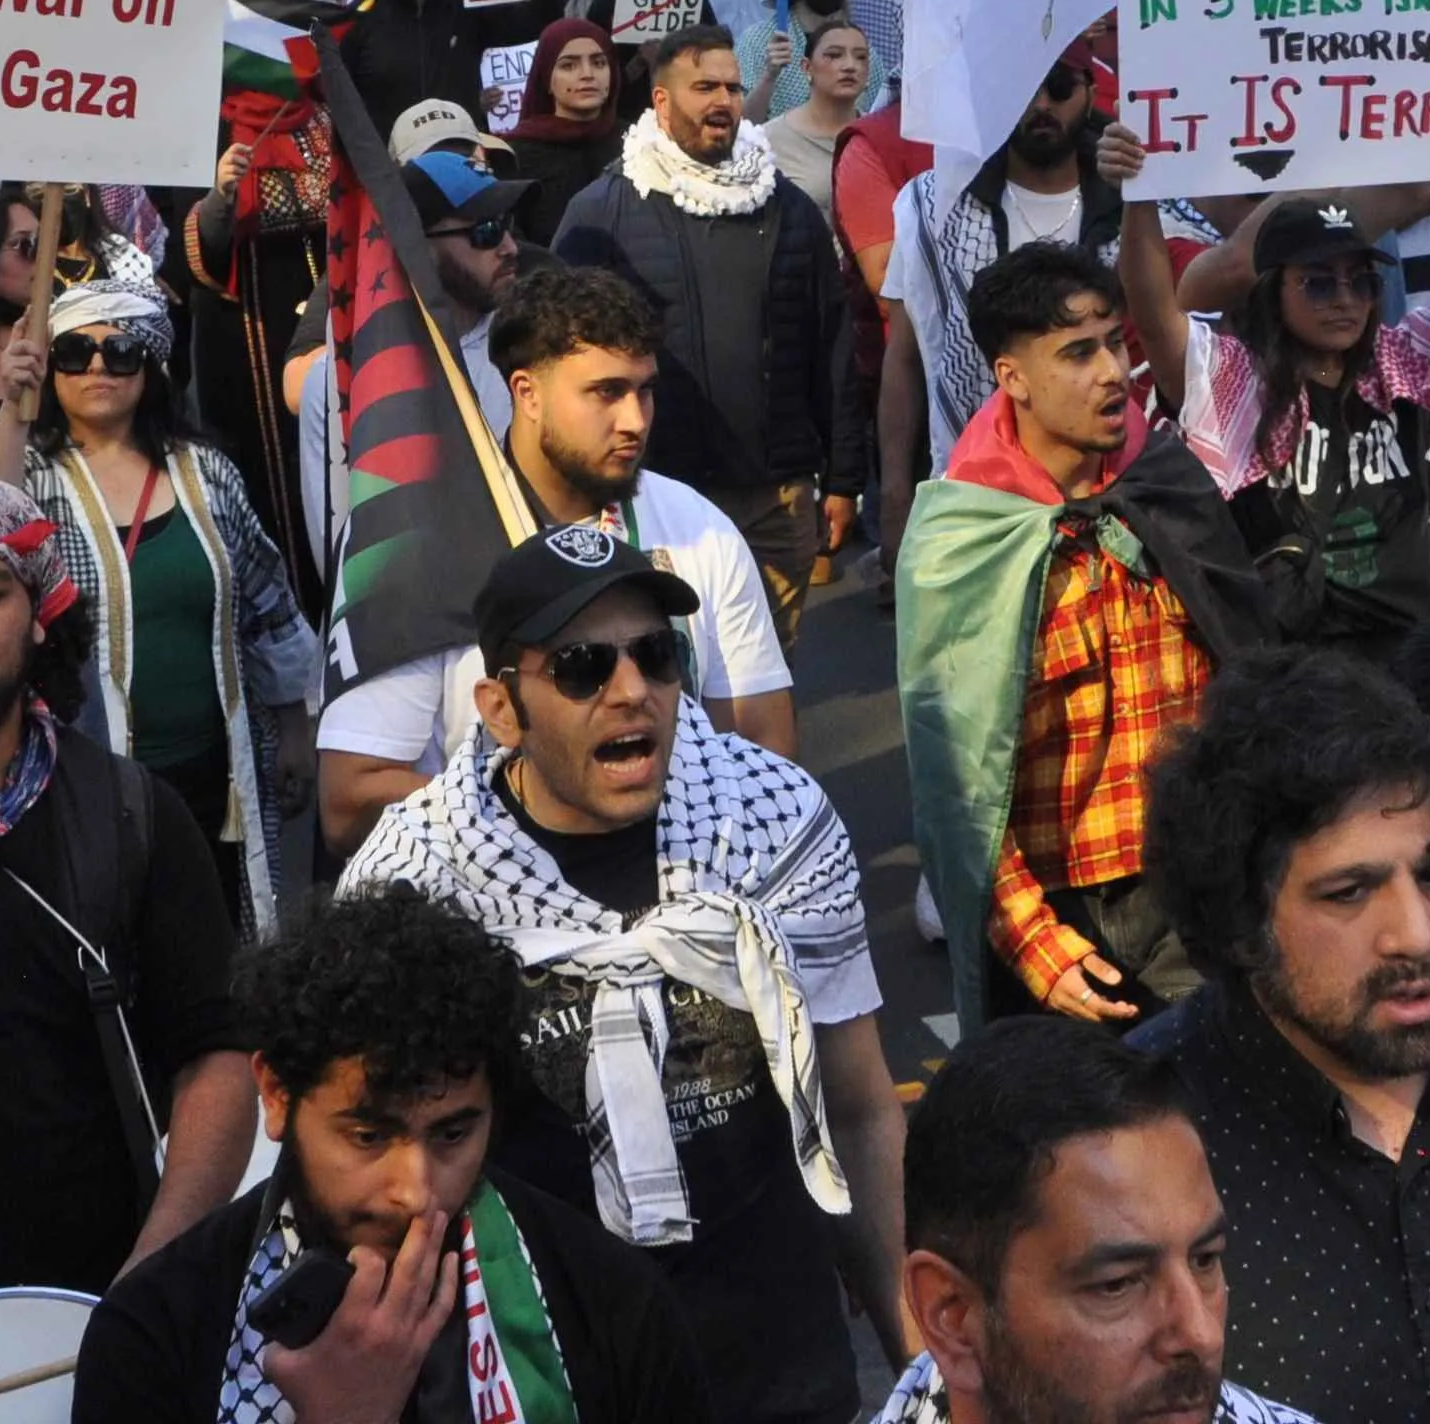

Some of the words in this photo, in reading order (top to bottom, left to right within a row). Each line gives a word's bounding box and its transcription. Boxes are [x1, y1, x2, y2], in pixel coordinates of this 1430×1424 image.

[0, 48, 138, 119] Gaza
[1229, 74, 1302, 148] IS
[670, 1103, 701, 1118] THE
[703, 1083, 756, 1110] OCEAN
[673, 1078, 712, 1100] 1988
